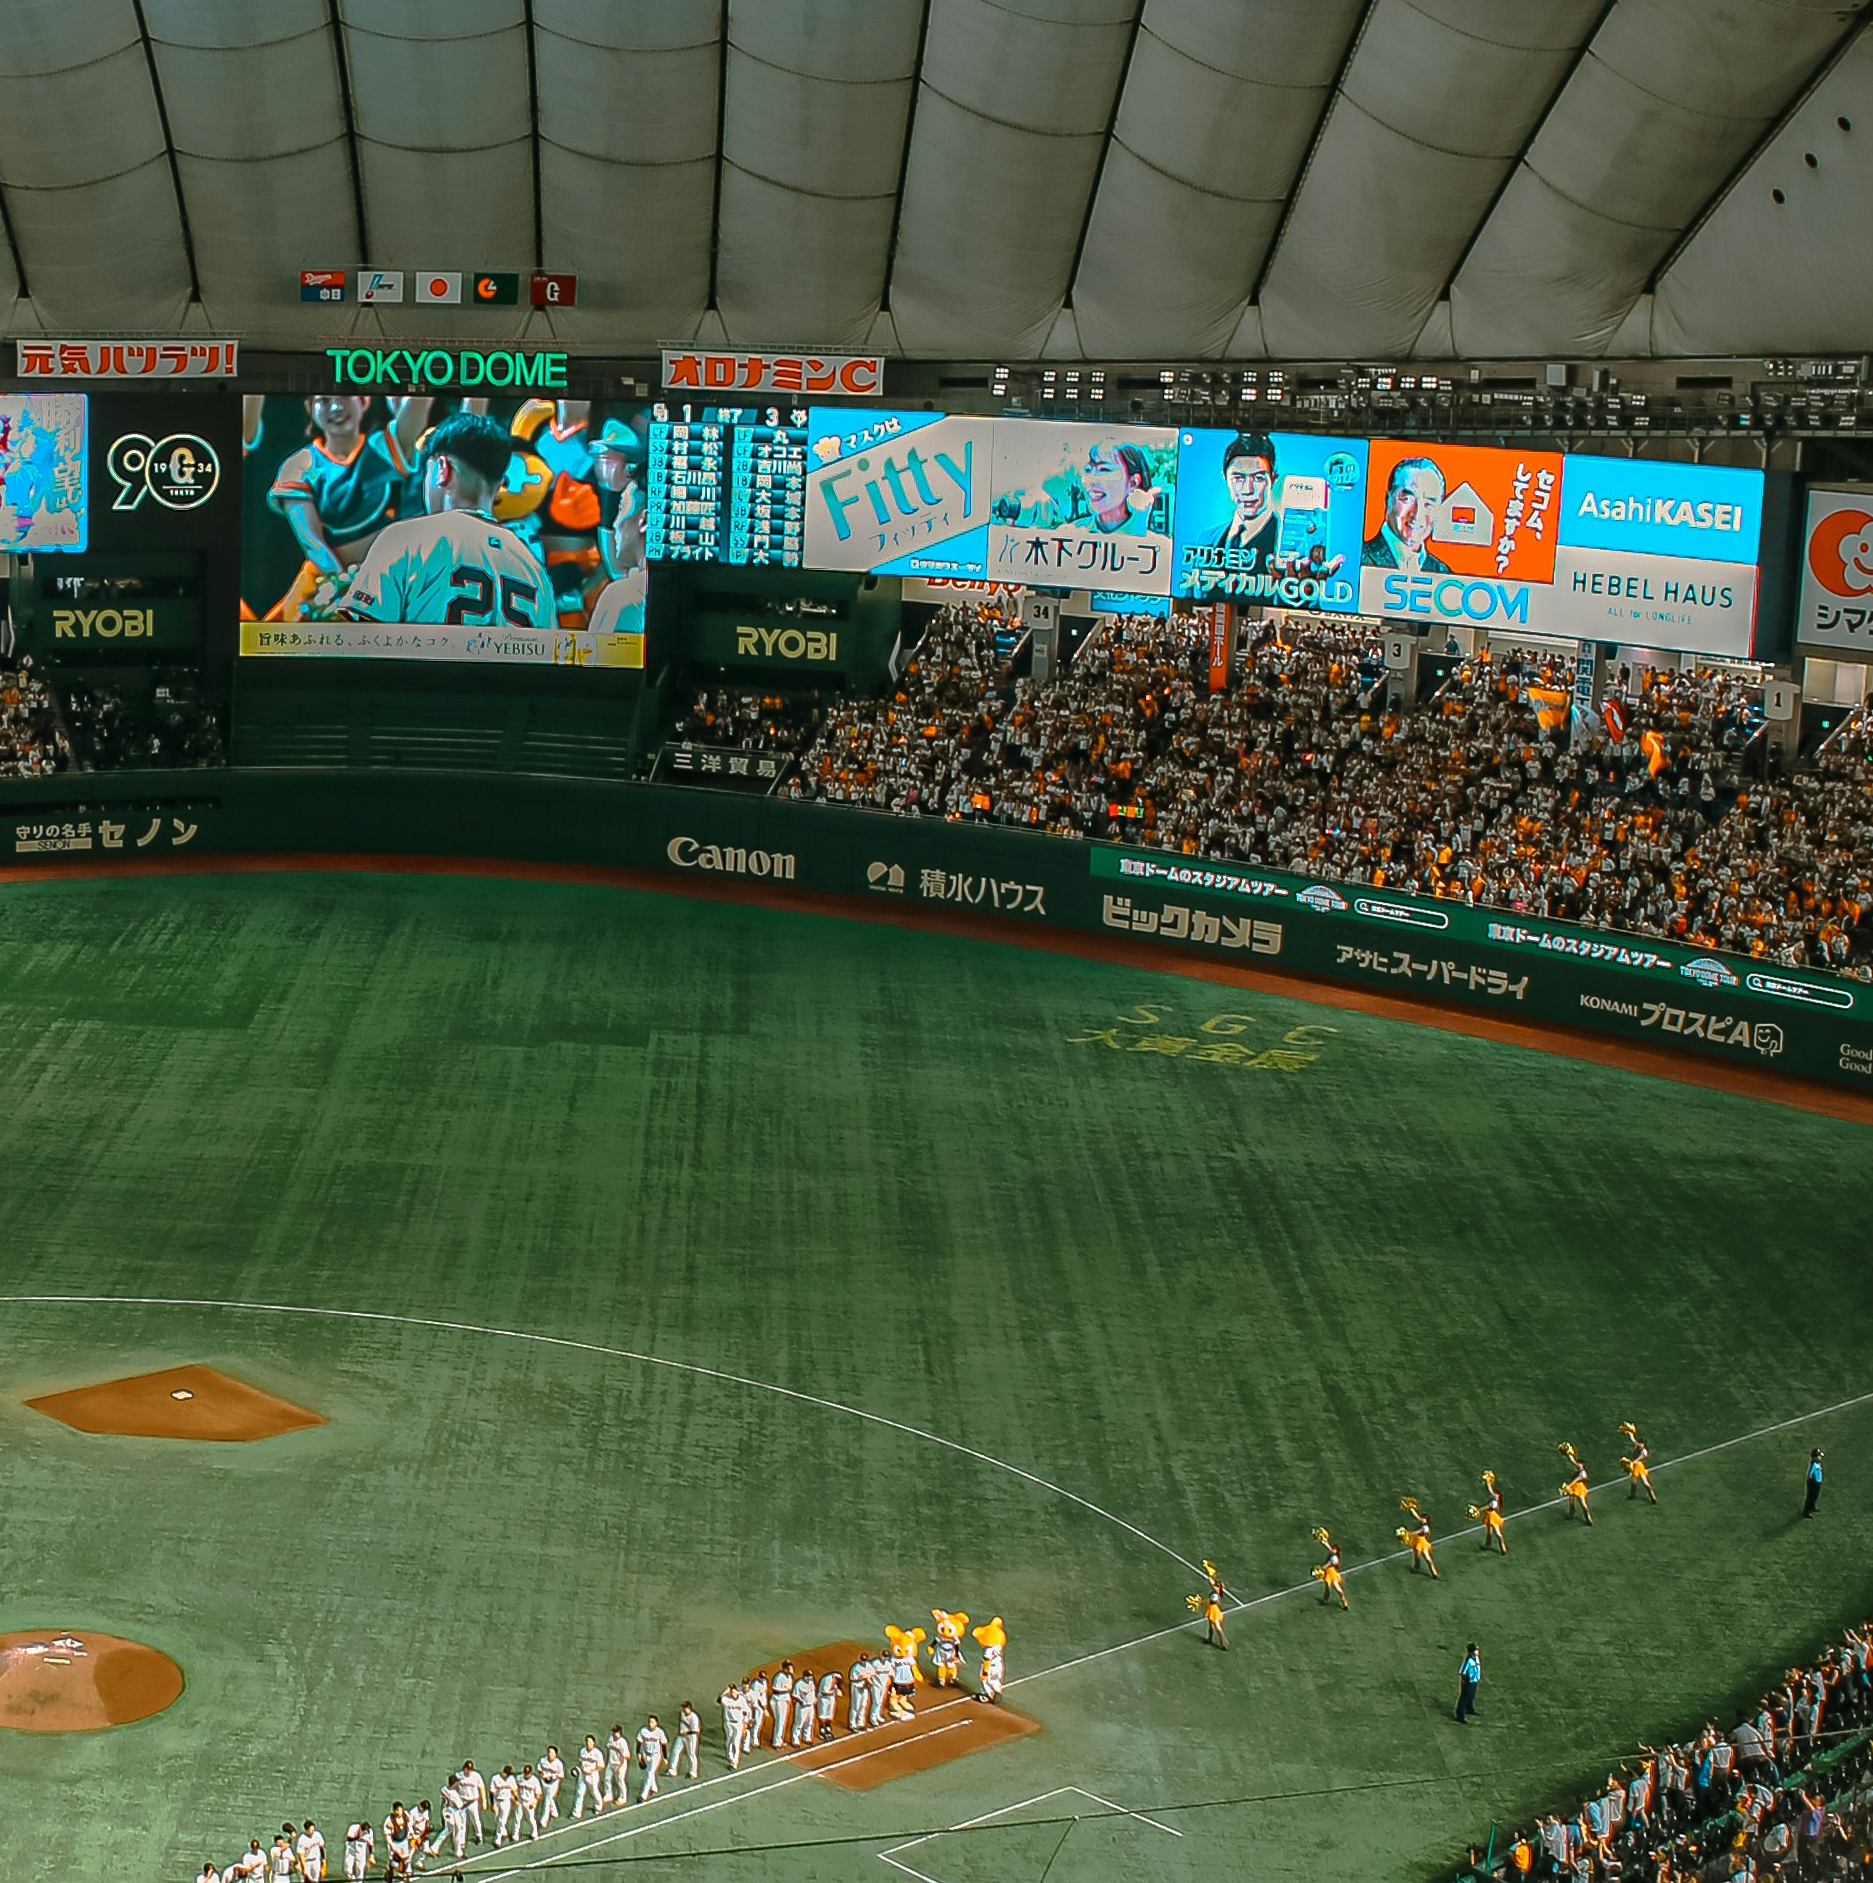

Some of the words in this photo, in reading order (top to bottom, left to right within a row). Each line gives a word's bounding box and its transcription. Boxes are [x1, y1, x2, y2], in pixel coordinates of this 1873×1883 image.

[22, 344, 235, 375] 元気ハツラツ!
[326, 348, 454, 385] TOKYO
[460, 350, 568, 387] DOME
[669, 354, 877, 393] オロナミンC
[842, 417, 902, 450] マスクは
[819, 441, 973, 542] Fitty
[868, 512, 950, 552] フィッティ
[1025, 536, 1161, 575] 木下グループ
[1181, 545, 1260, 570] アリナミン
[1179, 570, 1354, 604] メディカルGOLD
[1384, 573, 1530, 624] SECOM
[1572, 571, 1655, 601] HEBEL
[1663, 580, 1735, 609] HAUS
[52, 609, 154, 637] RYOBI
[1033, 605, 1049, 619] 34
[1607, 607, 1624, 618] ALL
[494, 641, 546, 656] YEBISU
[736, 626, 837, 661] RYOBI
[1392, 643, 1401, 658] 3
[1774, 691, 1782, 708] 1
[673, 752, 777, 777] 三洋貿易
[15, 821, 93, 840] 守りの名手
[98, 818, 198, 848] セノン
[666, 836, 796, 880] Canon
[919, 868, 1046, 915] 積水ハウス
[1103, 894, 1283, 955] ビックカメラ
[1336, 944, 1528, 1000] アサヒスーパードライ
[1579, 993, 1638, 1018] KONAMI
[1639, 1001, 1751, 1048] プロスピA
[1838, 1056, 1873, 1074] Good
[1839, 1043, 1873, 1062] Good
